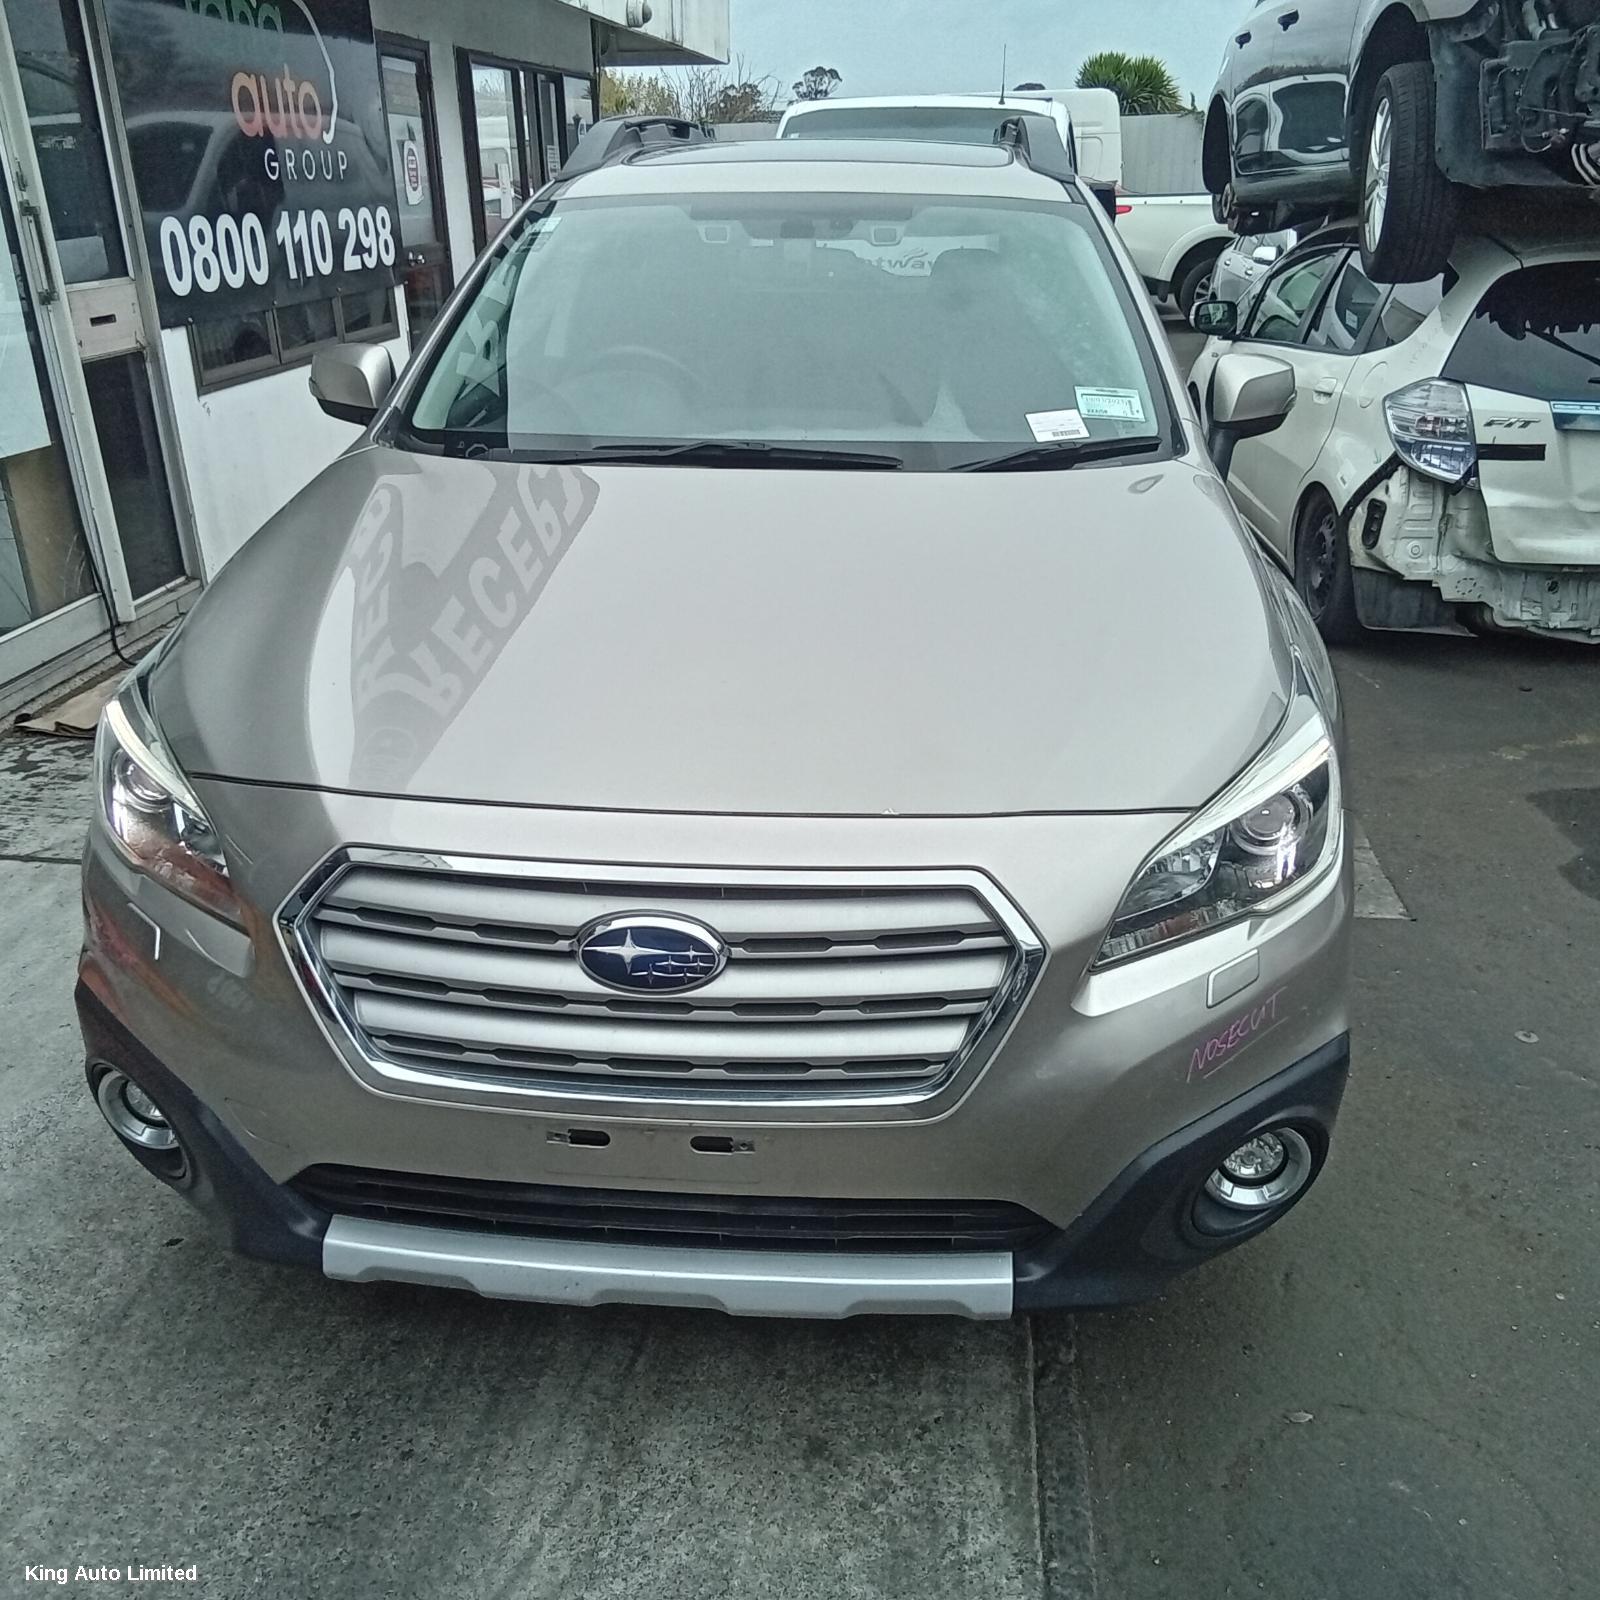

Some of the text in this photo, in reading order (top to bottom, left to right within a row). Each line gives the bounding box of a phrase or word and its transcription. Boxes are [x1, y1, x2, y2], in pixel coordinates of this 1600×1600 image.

[232, 63, 322, 140] auto
[264, 148, 347, 180] GROUP
[160, 206, 396, 297] 0800 110 298
[1483, 416, 1541, 429] FIT
